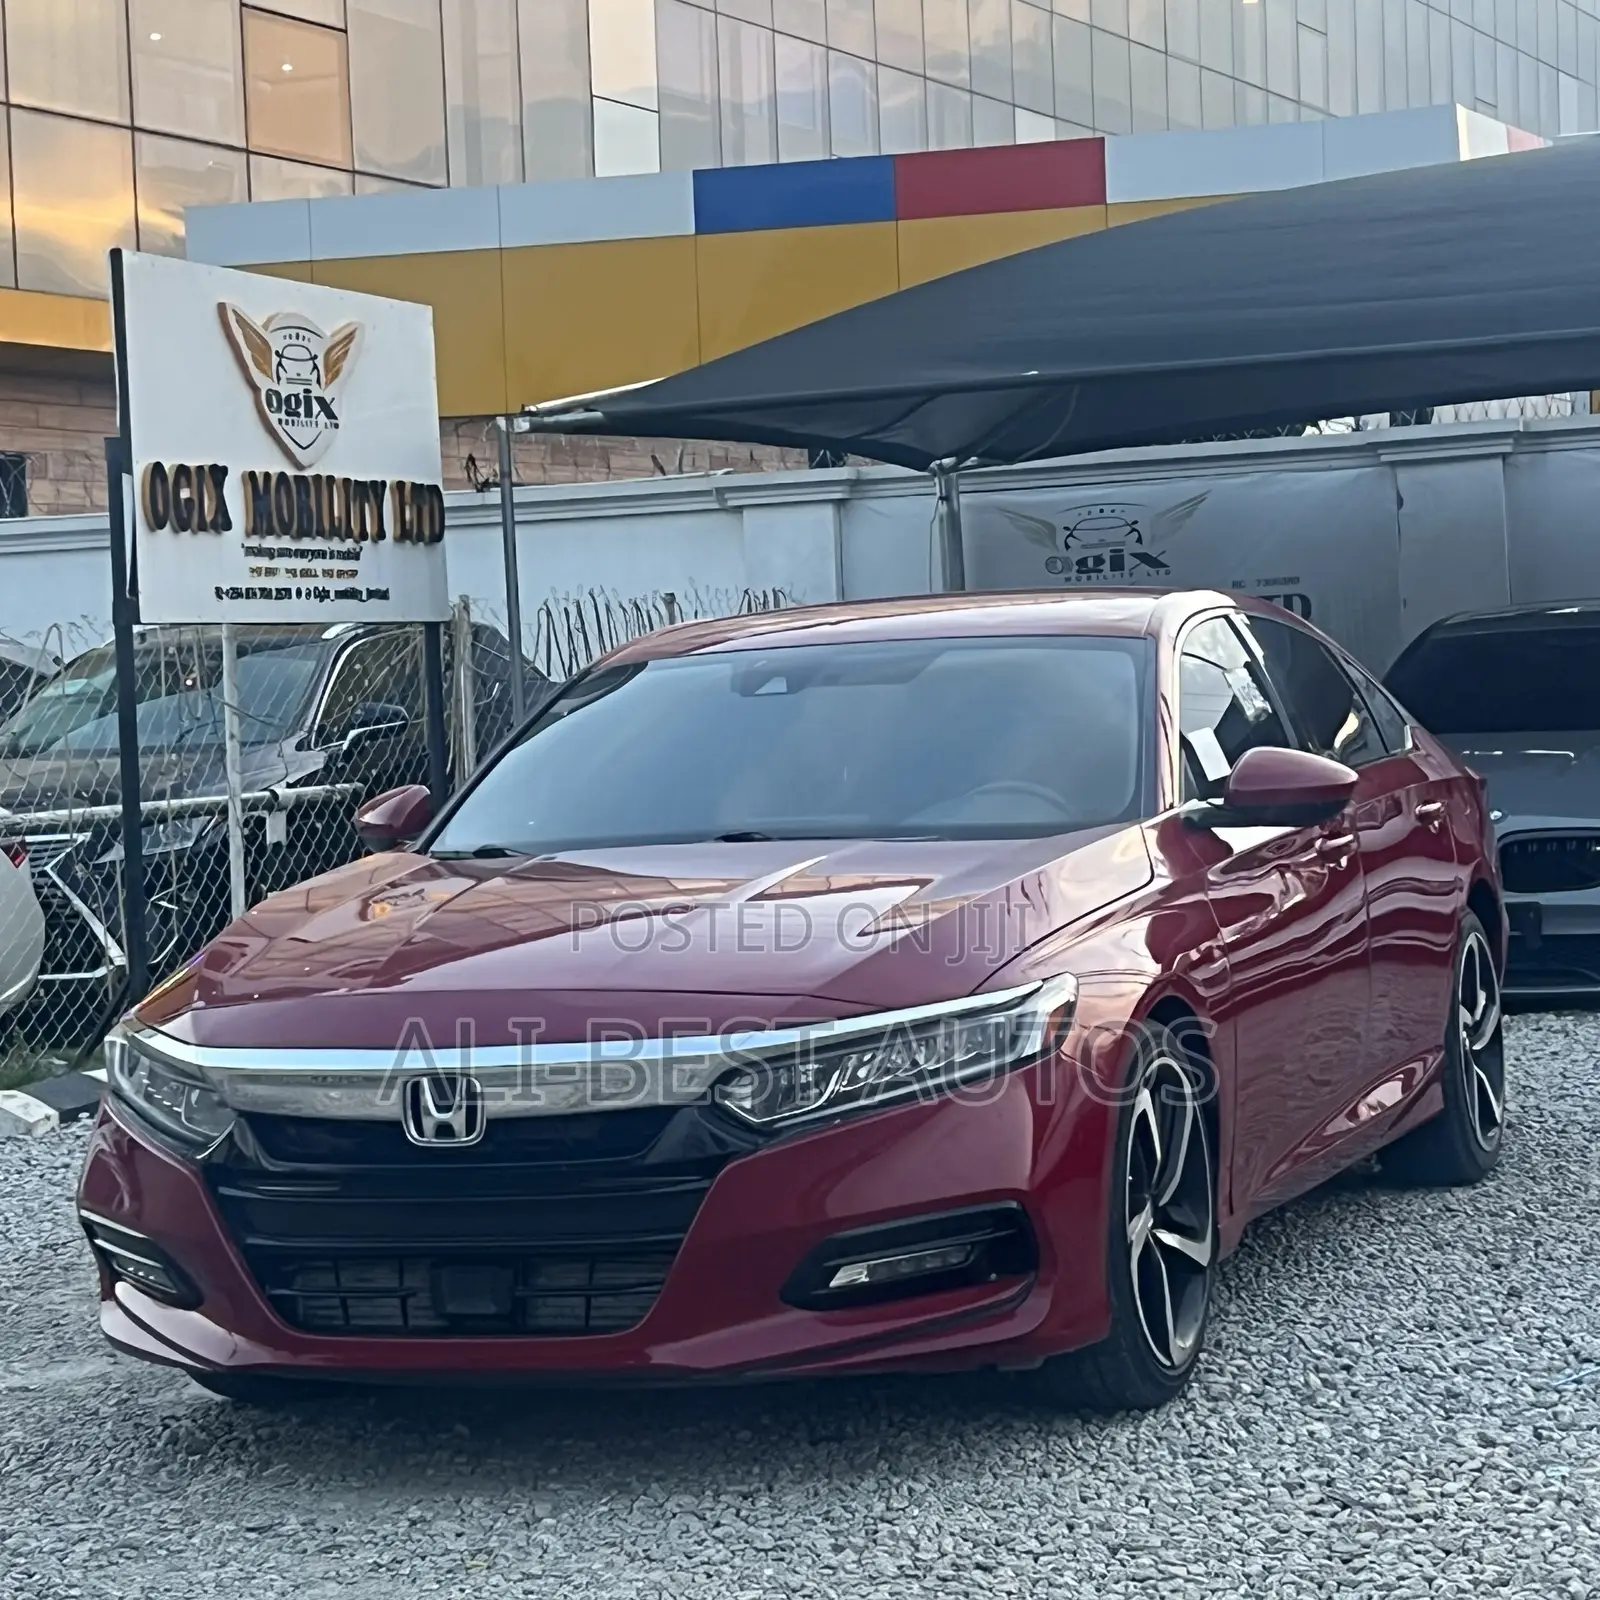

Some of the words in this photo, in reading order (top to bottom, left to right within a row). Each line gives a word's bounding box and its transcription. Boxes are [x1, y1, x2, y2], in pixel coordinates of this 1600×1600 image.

[142, 461, 232, 533] OGIX
[242, 471, 386, 543] MOBILITY
[390, 480, 445, 544] LTD
[1064, 573, 1135, 583] MOBILITY
[1146, 569, 1172, 578] LTD
